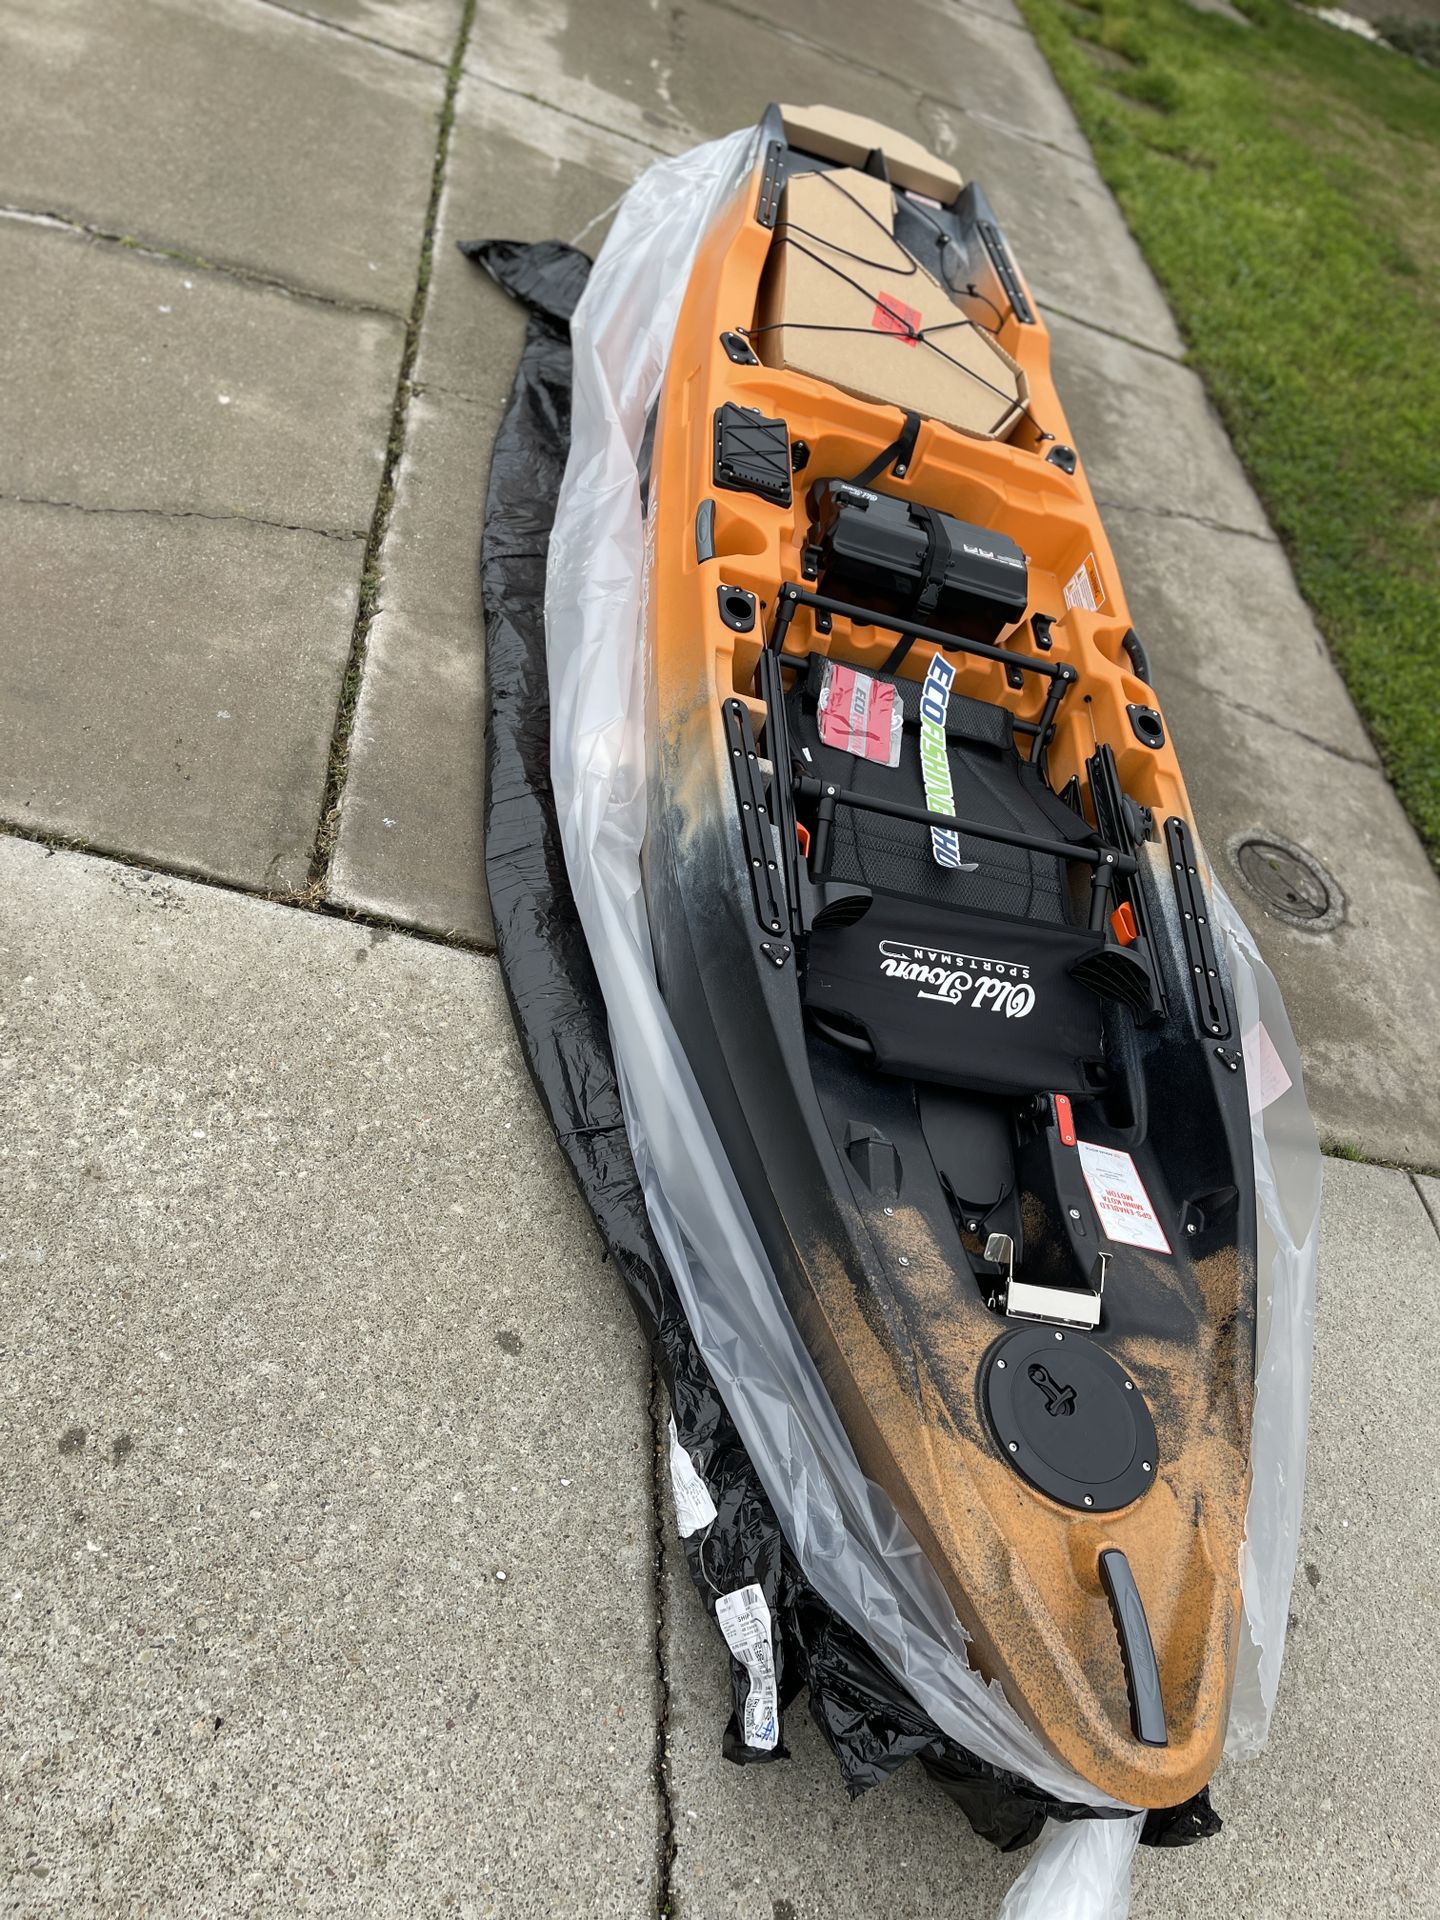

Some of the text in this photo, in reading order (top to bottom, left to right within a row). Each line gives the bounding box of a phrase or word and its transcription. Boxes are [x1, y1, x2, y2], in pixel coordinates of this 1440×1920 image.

[914, 949, 1030, 979] SPORTSMAN
[880, 958, 1035, 1018] Old Town
[1101, 1194, 1144, 1211] MINN KOTA
[1105, 1189, 1133, 1202] MOTOR
[1099, 1202, 1152, 1220] GPS-ENABLED
